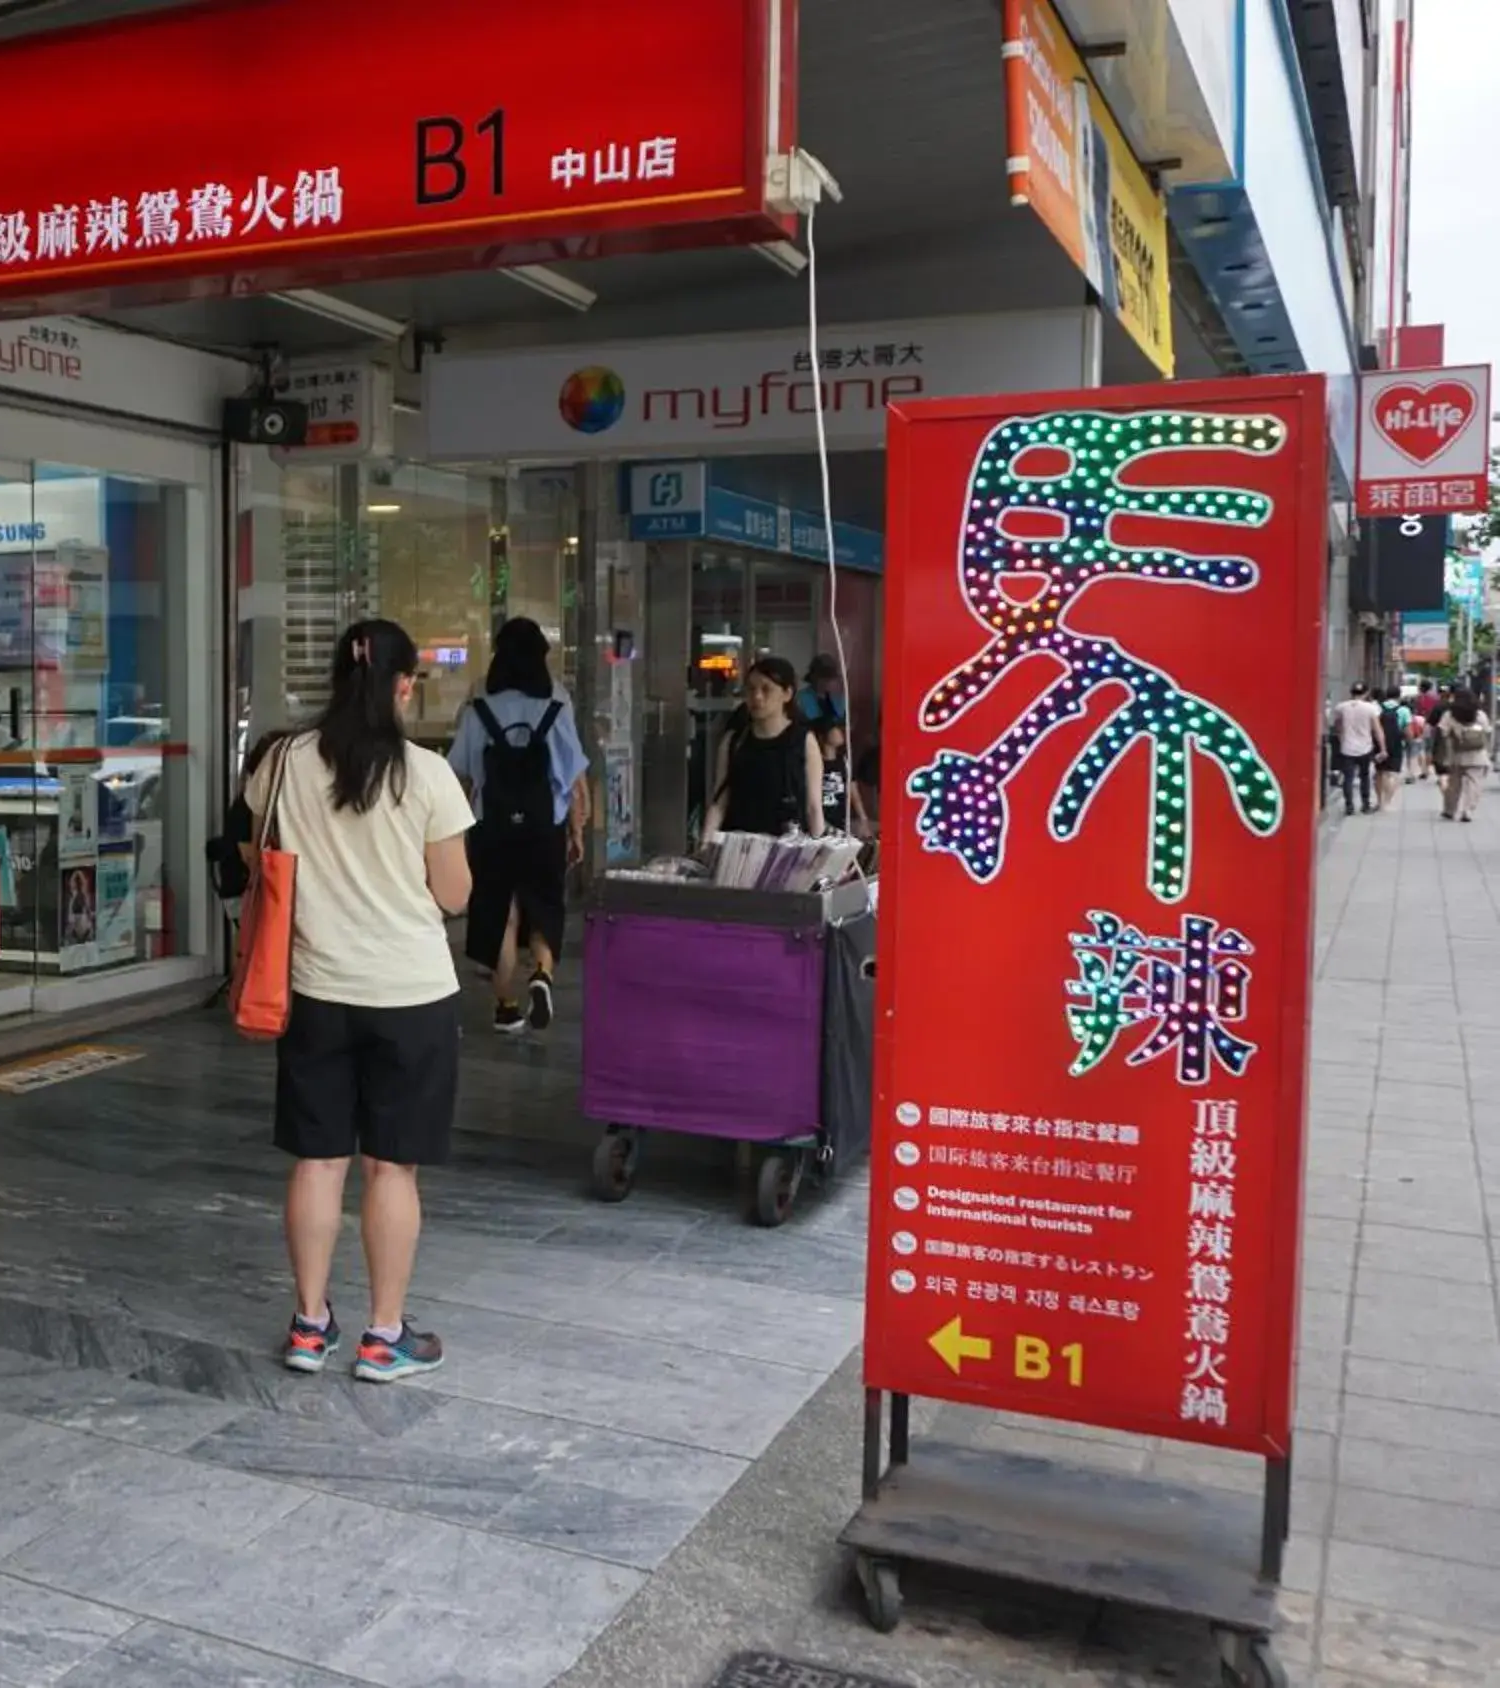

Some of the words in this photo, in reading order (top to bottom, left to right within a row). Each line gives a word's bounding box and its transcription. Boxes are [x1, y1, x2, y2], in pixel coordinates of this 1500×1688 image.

[415, 108, 505, 205] B1
[551, 136, 678, 190] 中山店
[793, 342, 924, 372] 台灣大哥大
[642, 368, 924, 429] myfone
[1370, 480, 1477, 509] 萊爾富
[647, 517, 687, 531] ATM
[928, 1105, 1140, 1145] 國際旅客來台指定餐廳
[927, 1185, 1016, 1207] Designated
[1019, 1196, 1105, 1219] restaurant
[1108, 1205, 1133, 1222] for
[1030, 1214, 1093, 1235] tourists
[1179, 1098, 1240, 1427] 頂級麻辣鴛鴦火鍋
[925, 1276, 958, 1296] 외국
[966, 1279, 1017, 1304] 관광객
[1025, 1288, 1060, 1311] 지정
[1068, 1294, 1141, 1322] 레스토랑
[1014, 1334, 1084, 1387] B1
